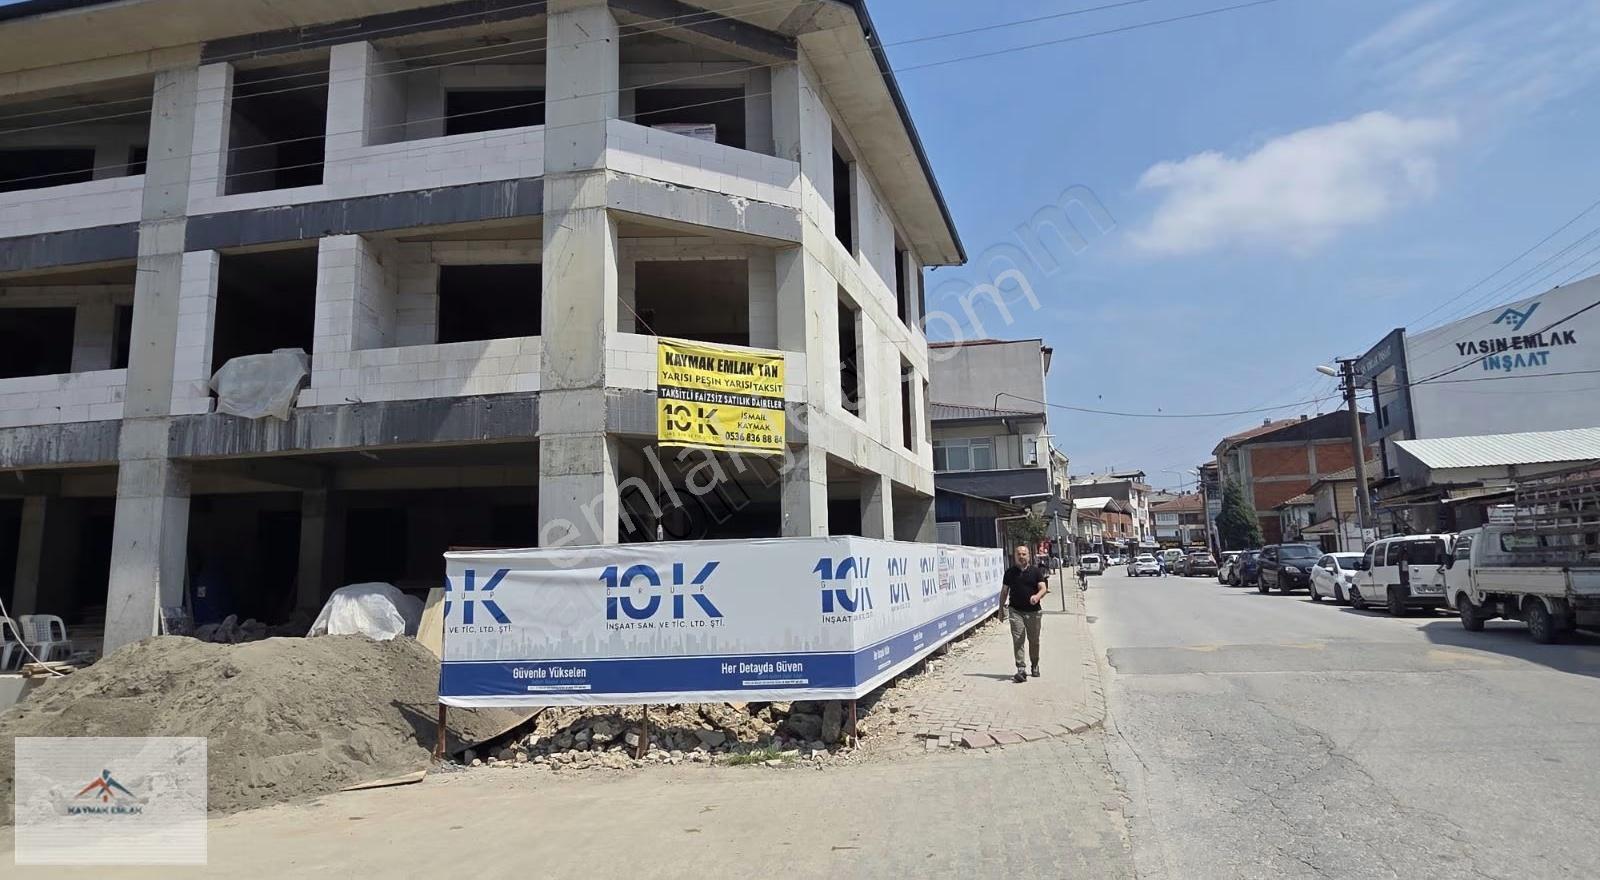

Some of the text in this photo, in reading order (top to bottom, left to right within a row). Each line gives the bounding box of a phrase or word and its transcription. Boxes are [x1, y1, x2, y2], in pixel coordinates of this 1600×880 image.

[1456, 330, 1577, 356] YASİN EMLAK
[665, 351, 715, 372] KAYMAK
[1482, 350, 1550, 372] İNŞAAT
[662, 370, 692, 383] YARISI
[724, 378, 753, 390] YARISI
[753, 382, 783, 393] TAKSİT
[724, 395, 750, 407] SATILIK
[737, 421, 771, 432] KAYMAK
[725, 431, 745, 442] 0536
[746, 431, 760, 443] 836
[762, 434, 772, 443] 88
[822, 615, 852, 624] İNŞAAT
[449, 626, 459, 634] VE
[606, 621, 635, 631] İNŞAAT
[513, 666, 587, 679] Güvenle Yükselen
[721, 660, 803, 675] Her Detayda Güven
